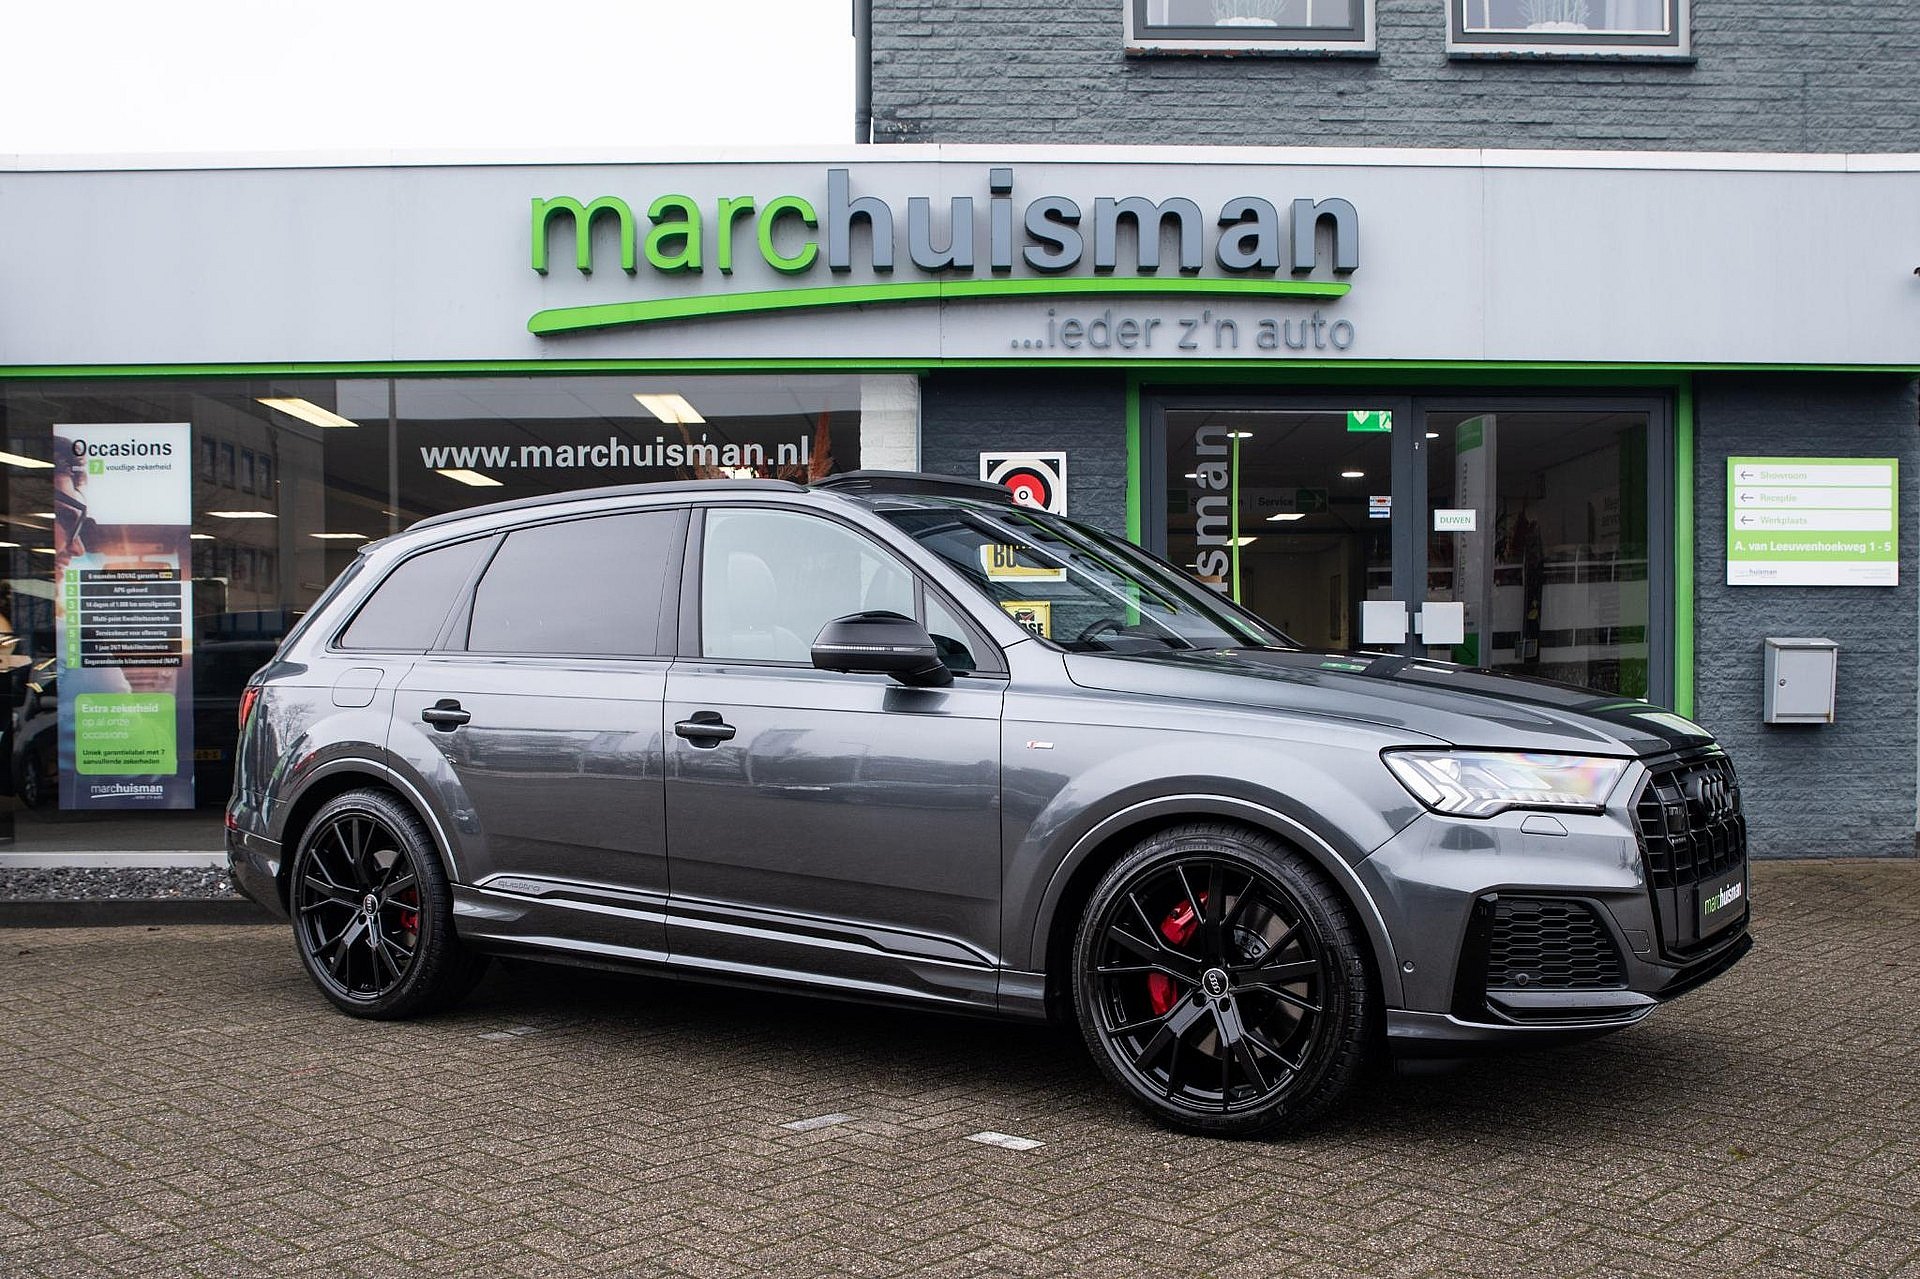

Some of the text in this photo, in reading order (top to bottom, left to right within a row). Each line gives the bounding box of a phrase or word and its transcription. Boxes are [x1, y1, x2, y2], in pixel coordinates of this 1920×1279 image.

[531, 168, 1359, 276] marchuisman
[1176, 309, 1238, 350] z'n
[1256, 314, 1355, 350] auto
[72, 438, 172, 457] Occasions
[420, 434, 810, 468] www.marchuisman.nl
[105, 463, 135, 472] voudige
[136, 463, 172, 472] zekerheid
[1760, 470, 1808, 480] Showroom
[1760, 493, 1797, 503] Receptie
[1760, 516, 1808, 526] Werkplaats
[1748, 543, 1767, 551] van
[1770, 540, 1866, 554] Leeuwenhoekweg
[81, 703, 159, 714] Extra zekerheid
[90, 783, 164, 793] marchuisman
[1703, 881, 1742, 916] marchuisman
